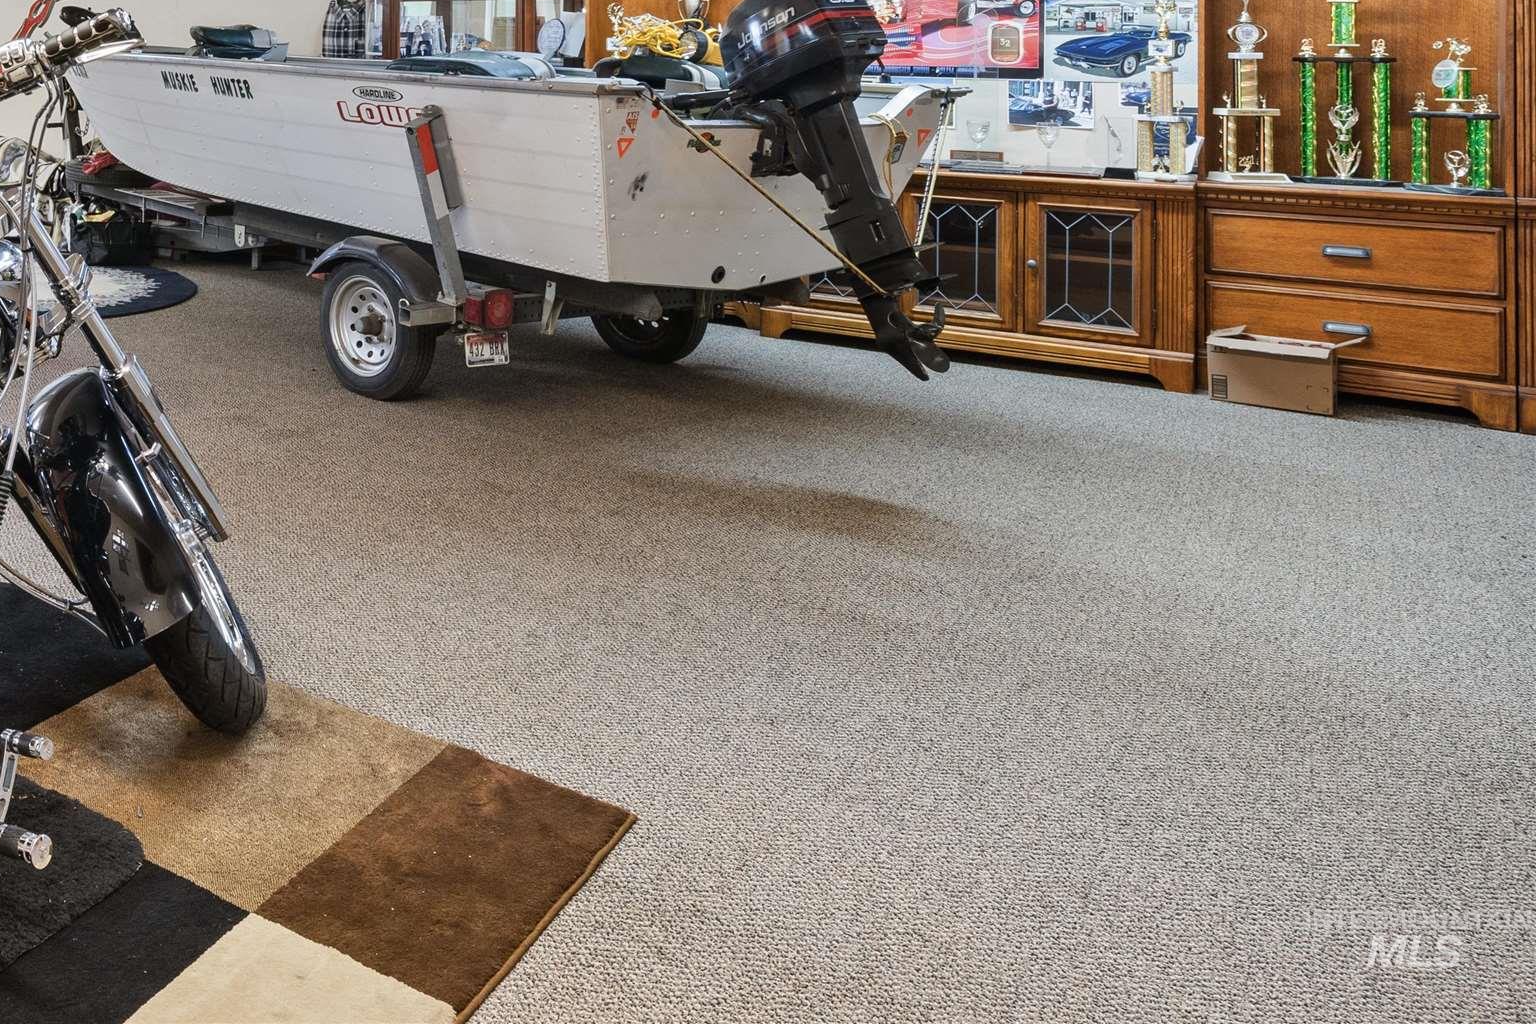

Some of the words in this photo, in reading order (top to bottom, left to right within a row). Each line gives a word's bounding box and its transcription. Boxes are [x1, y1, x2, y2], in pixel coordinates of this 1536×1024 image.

[737, 6, 795, 49] Jonson
[161, 70, 199, 93] MUSKIE
[210, 76, 254, 100] HUNTER
[359, 88, 397, 100] HARDLINE
[470, 342, 485, 357] 432
